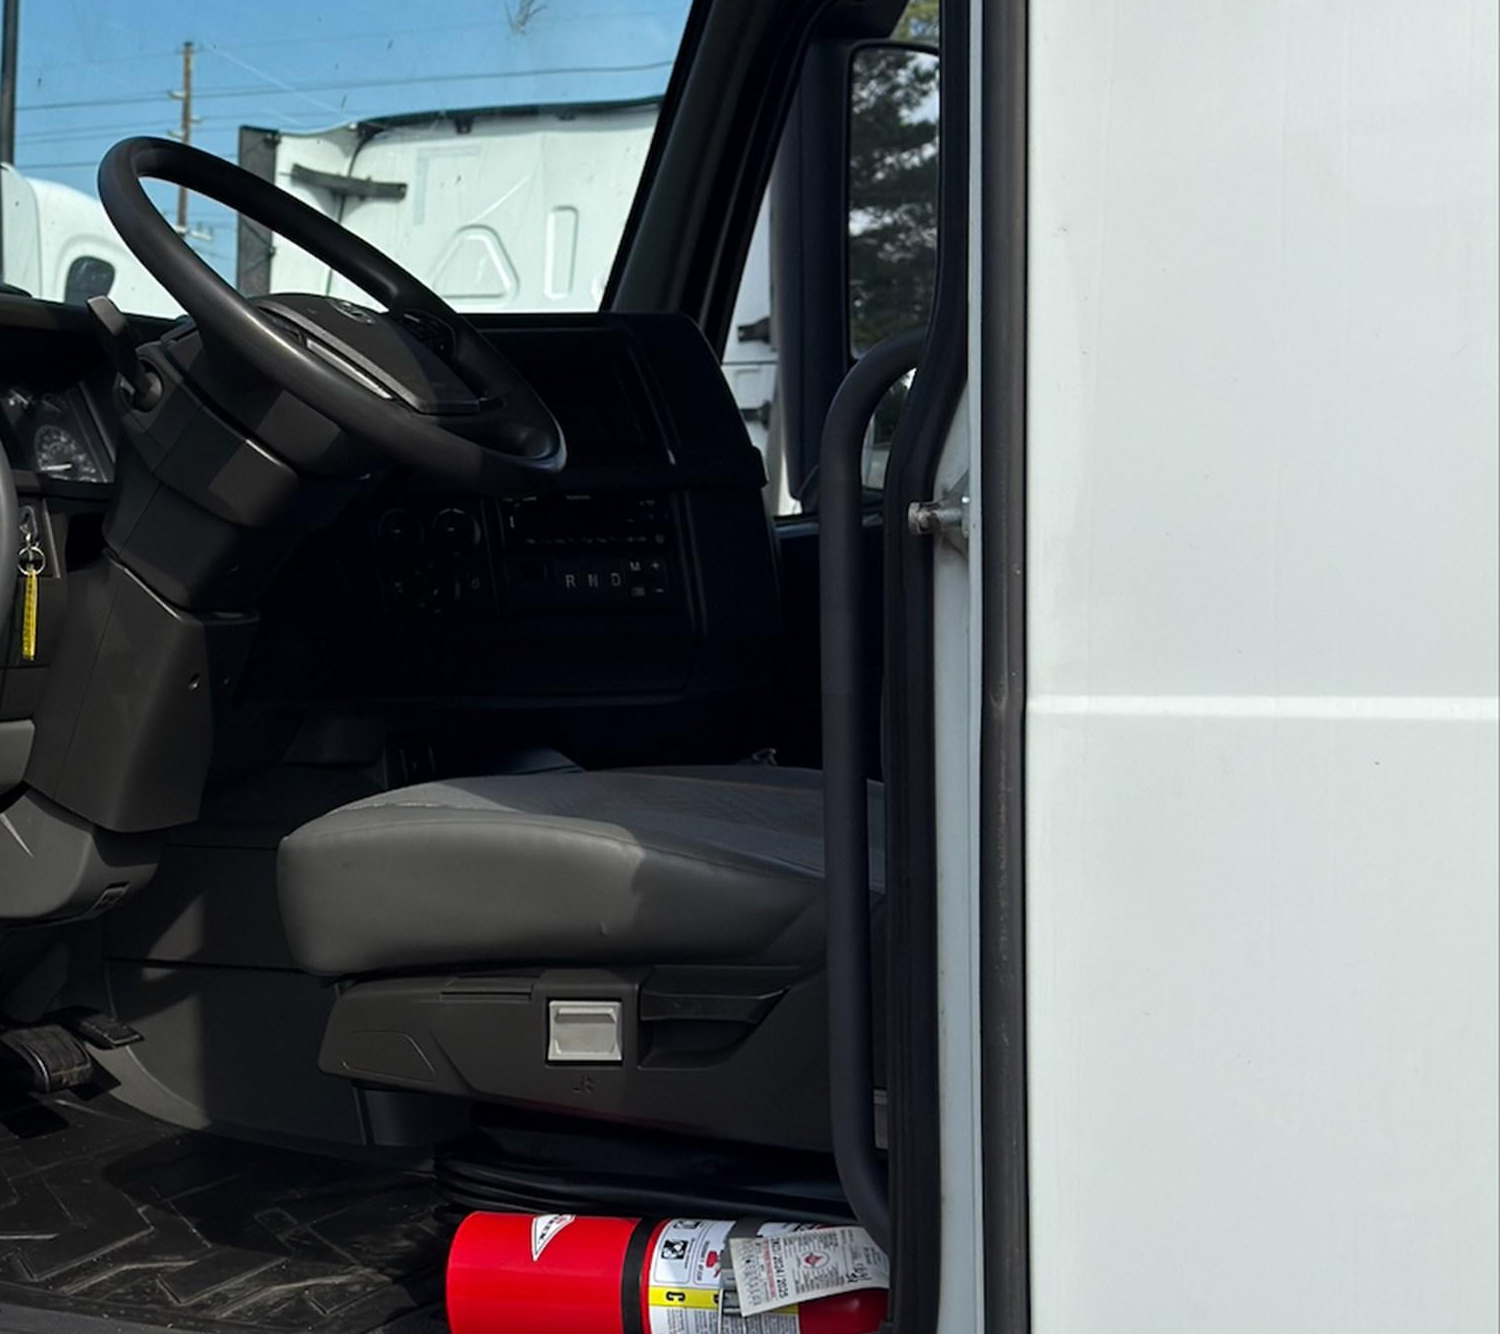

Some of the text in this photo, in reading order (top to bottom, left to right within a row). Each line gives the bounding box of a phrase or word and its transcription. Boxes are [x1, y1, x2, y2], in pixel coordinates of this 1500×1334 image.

[565, 572, 621, 588] R N D
[666, 1291, 686, 1302] C
